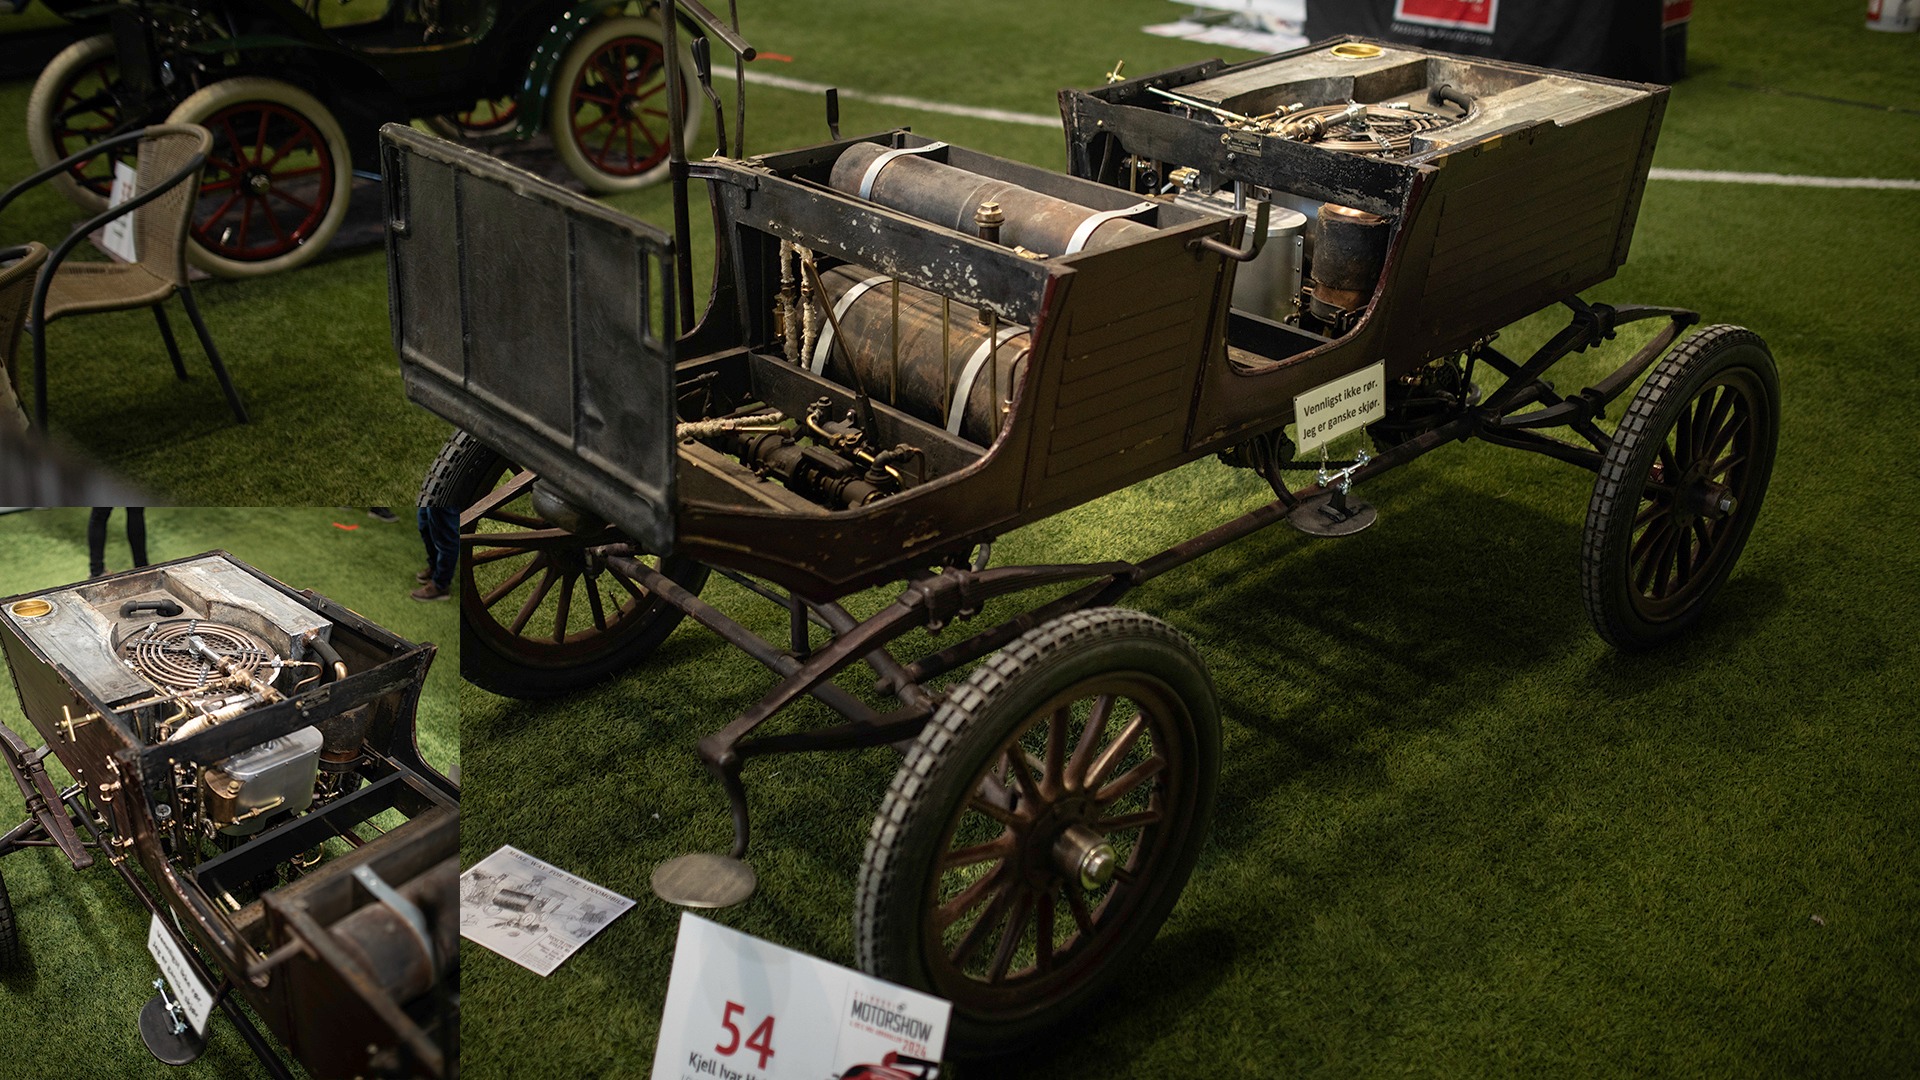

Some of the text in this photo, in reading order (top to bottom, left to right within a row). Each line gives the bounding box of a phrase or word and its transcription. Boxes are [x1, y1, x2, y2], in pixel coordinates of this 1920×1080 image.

[1303, 380, 1378, 417] Vennligst ikke rør.
[1303, 399, 1380, 440] Jeg er ganske skjør.
[509, 850, 627, 907] MAKE WAY FOR THE LOCOMOBILE
[714, 1000, 776, 1071] 54
[851, 998, 933, 1043] MOTORSHOW
[689, 1051, 717, 1077] Kjell
[902, 1039, 927, 1057] 2024
